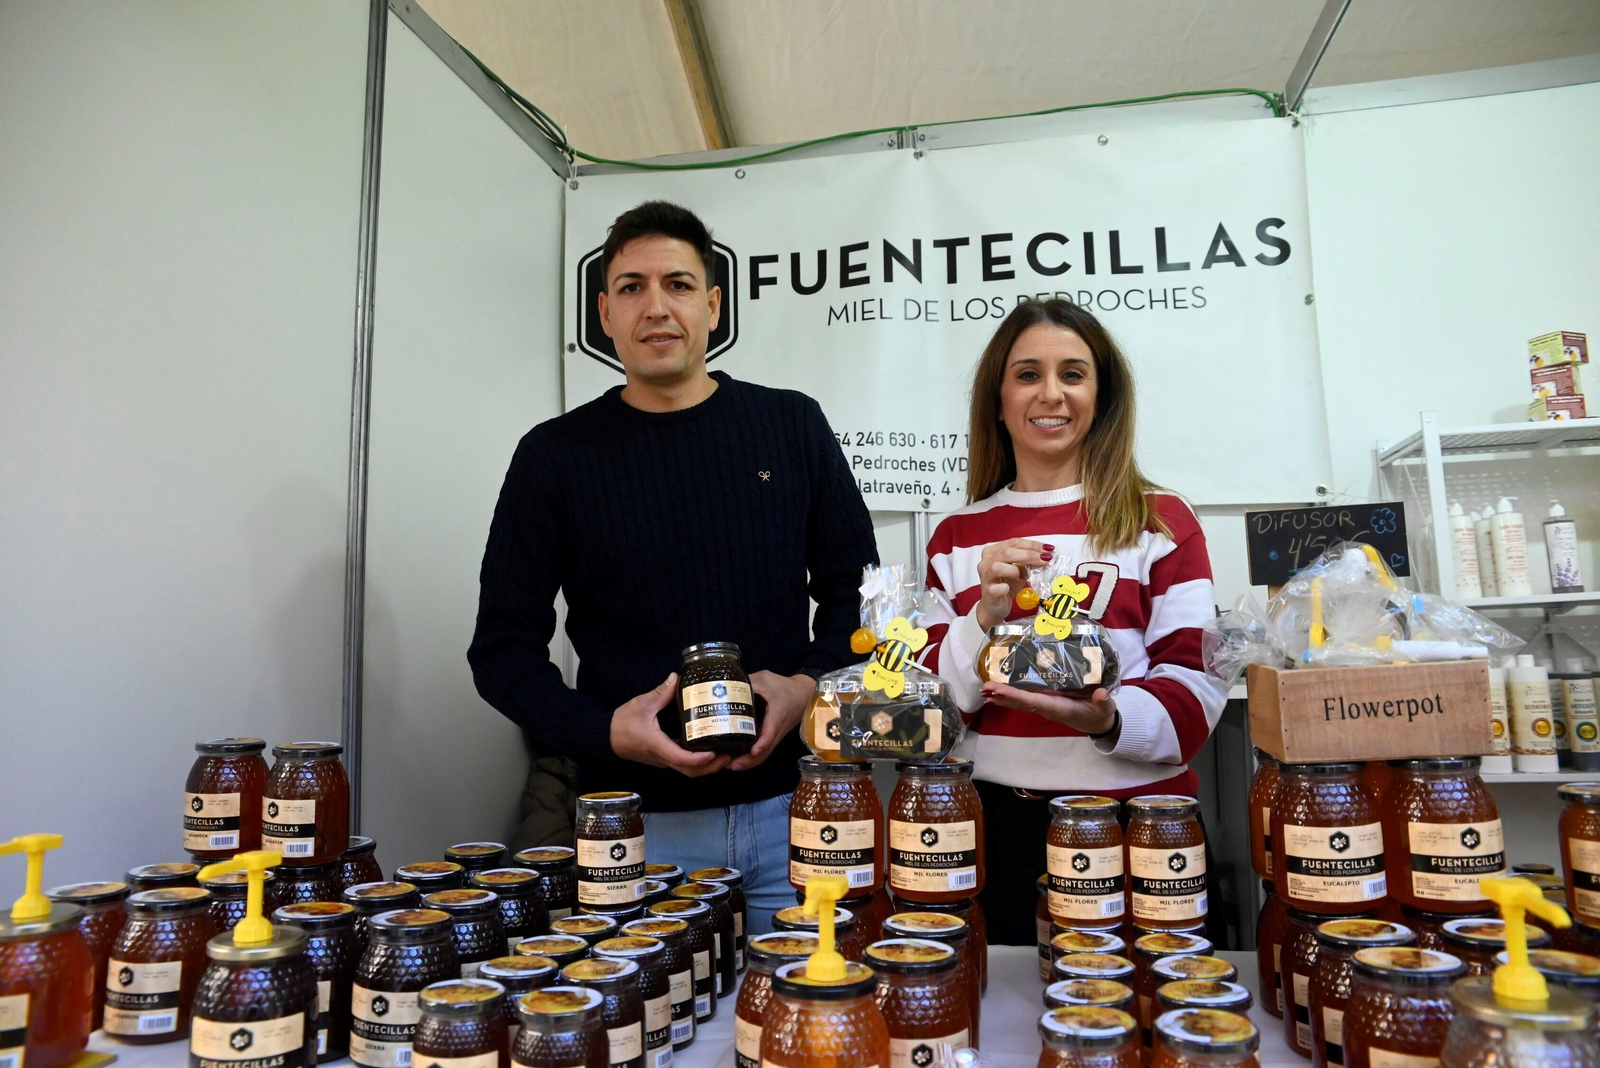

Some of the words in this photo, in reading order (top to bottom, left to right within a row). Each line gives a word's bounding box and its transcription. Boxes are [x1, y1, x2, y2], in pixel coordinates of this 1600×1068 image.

[749, 217, 1291, 301] FUENTECILLAS
[827, 298, 893, 326] MIEL
[903, 298, 940, 322] DE
[950, 296, 1005, 322] LOS
[856, 431, 884, 447] 246
[889, 432, 916, 448] 630
[930, 433, 957, 449] 617
[852, 455, 936, 472] Pedroches
[941, 481, 951, 496] 4
[1076, 561, 1120, 620] 7
[694, 704, 746, 714] FUENTECILLAS
[1323, 693, 1444, 722] Flowerpot
[799, 849, 862, 859] FUENTECILLAS
[899, 852, 963, 862] FUENTECILLAS
[1431, 855, 1502, 867] FUENTECILLAS
[1302, 858, 1376, 869] FUENTECILLAS
[588, 865, 644, 877] FUENTECILLAS
[1052, 877, 1115, 888] FUENTECILLAS
[1143, 876, 1205, 889] FUENTECILLAS
[353, 1019, 416, 1035] FUENTECILLAS
